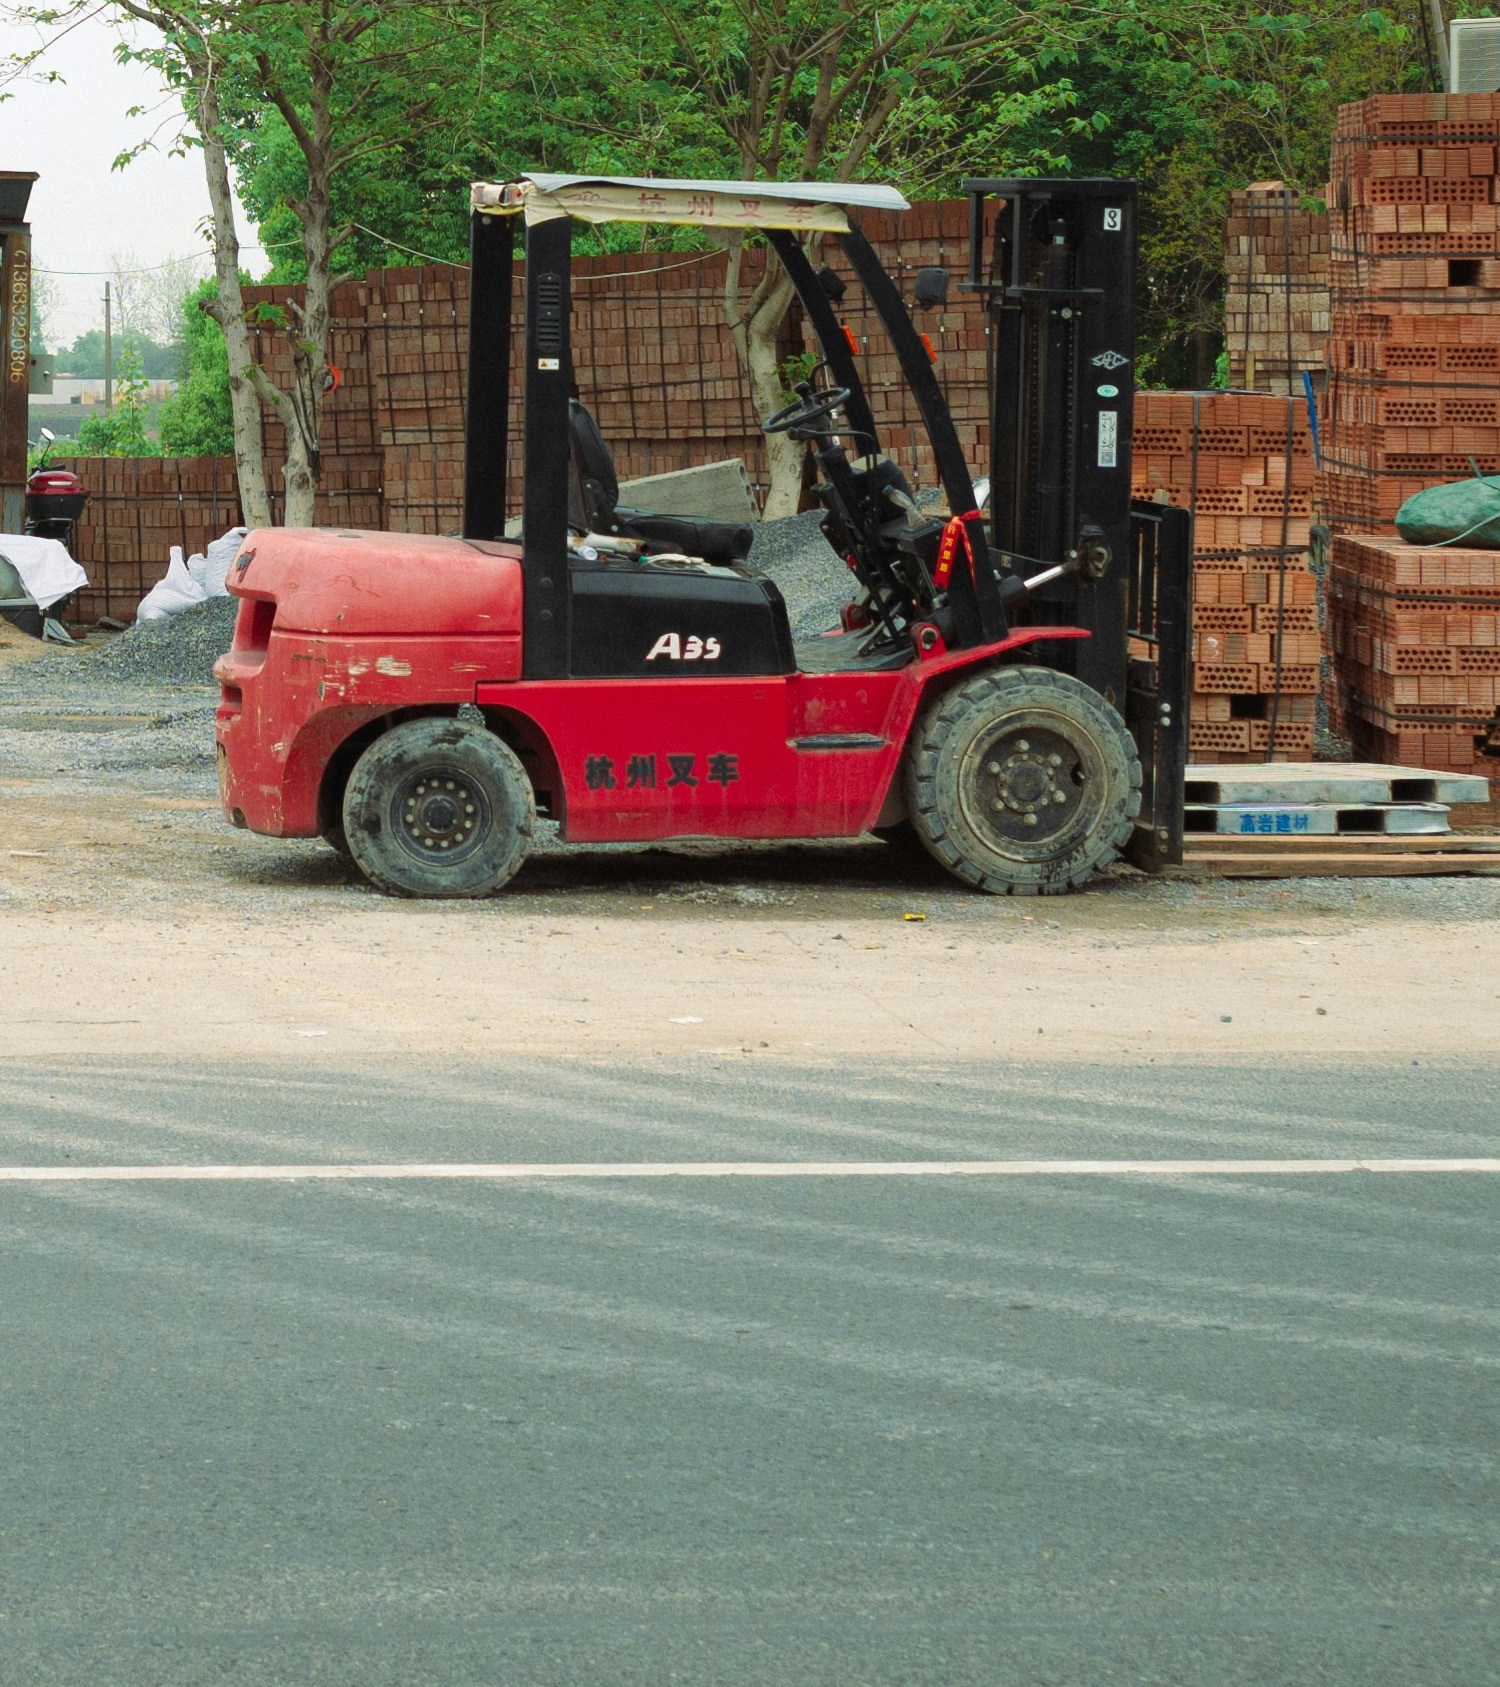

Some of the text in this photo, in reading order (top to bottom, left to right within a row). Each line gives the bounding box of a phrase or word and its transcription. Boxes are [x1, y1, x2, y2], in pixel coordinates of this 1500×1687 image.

[637, 192, 815, 223] 杭州叉车
[584, 752, 741, 790] 杭州叉车
[1239, 813, 1309, 833] 高岩建材
